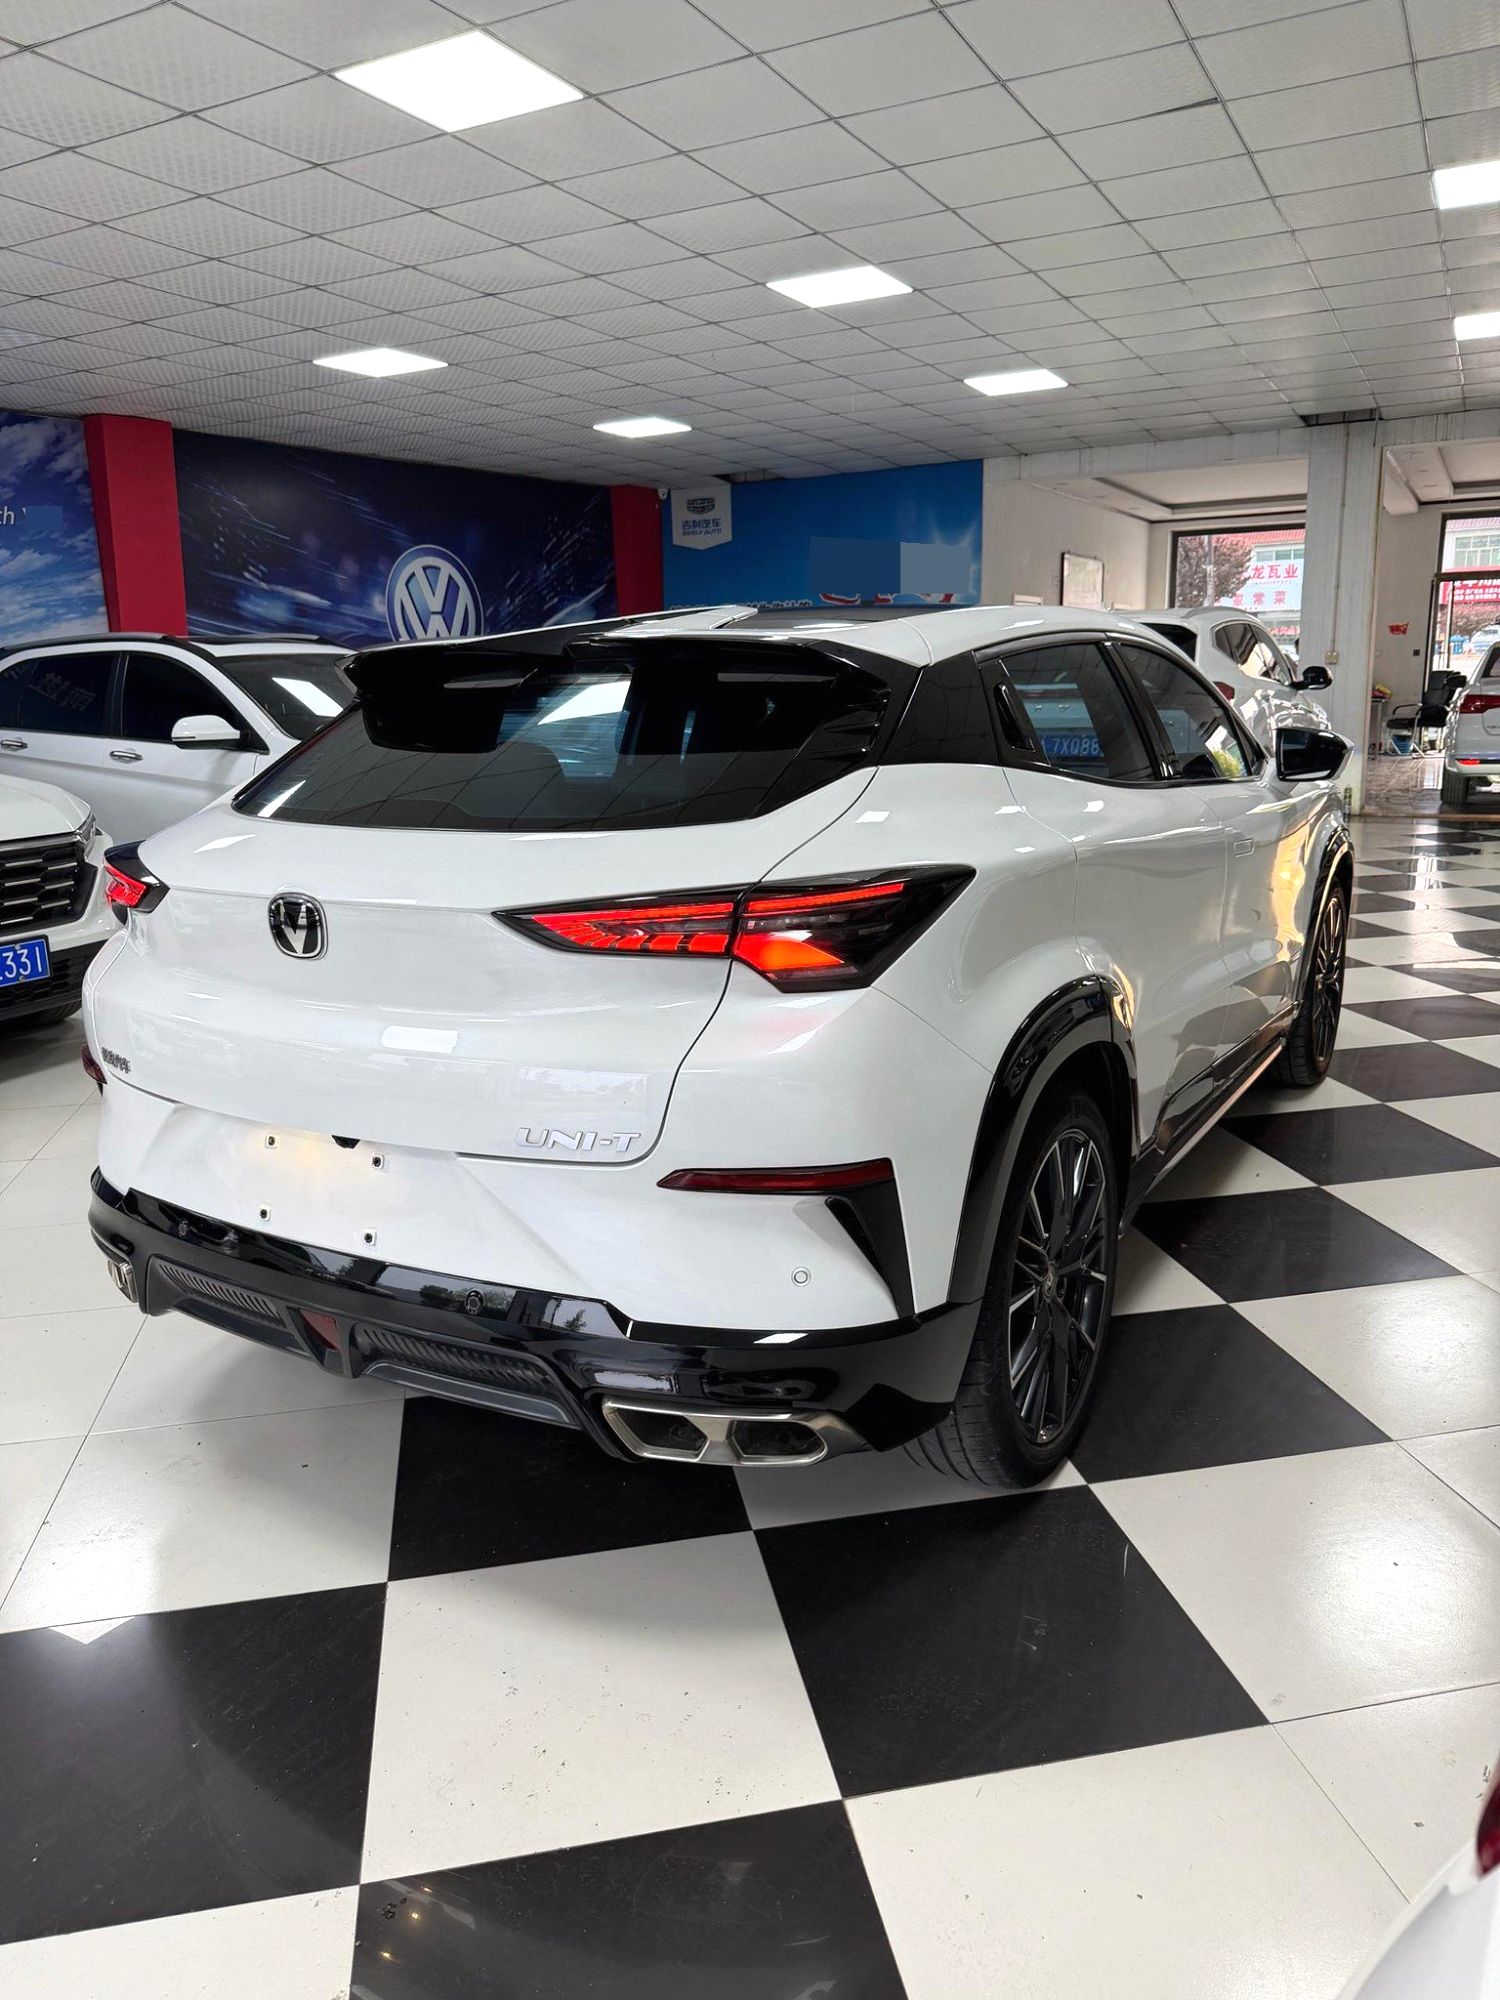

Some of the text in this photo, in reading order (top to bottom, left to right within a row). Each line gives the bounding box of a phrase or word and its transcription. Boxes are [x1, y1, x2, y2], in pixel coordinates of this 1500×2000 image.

[1240, 563, 1298, 580] 龙瓦业
[0, 946, 42, 979] 331
[515, 1127, 641, 1152] UNI-T
